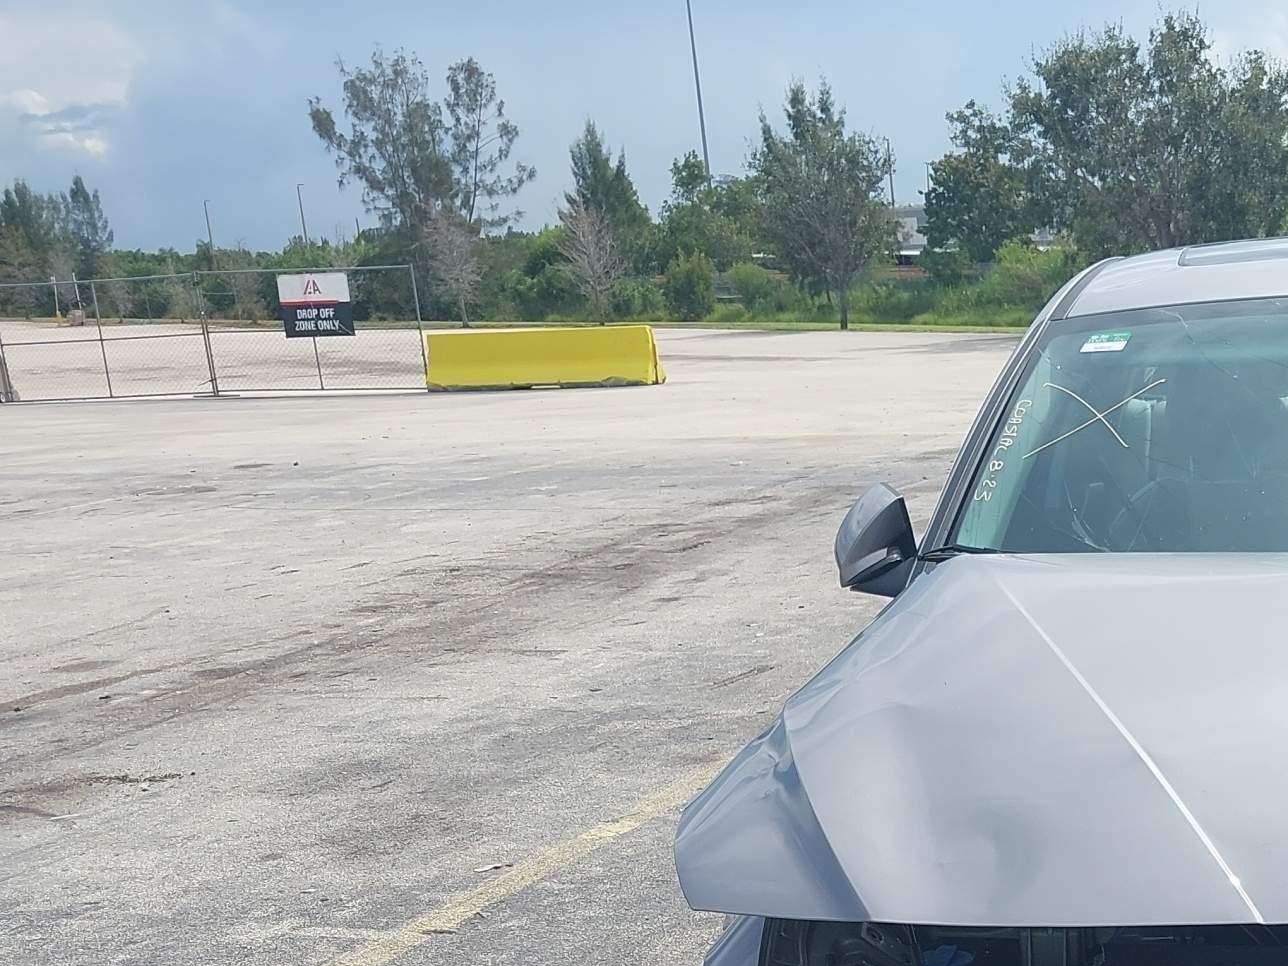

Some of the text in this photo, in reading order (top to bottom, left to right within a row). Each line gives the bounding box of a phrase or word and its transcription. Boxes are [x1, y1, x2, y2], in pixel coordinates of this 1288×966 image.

[296, 308, 335, 319] DROP OFF
[294, 320, 340, 330] ZONE ONLY
